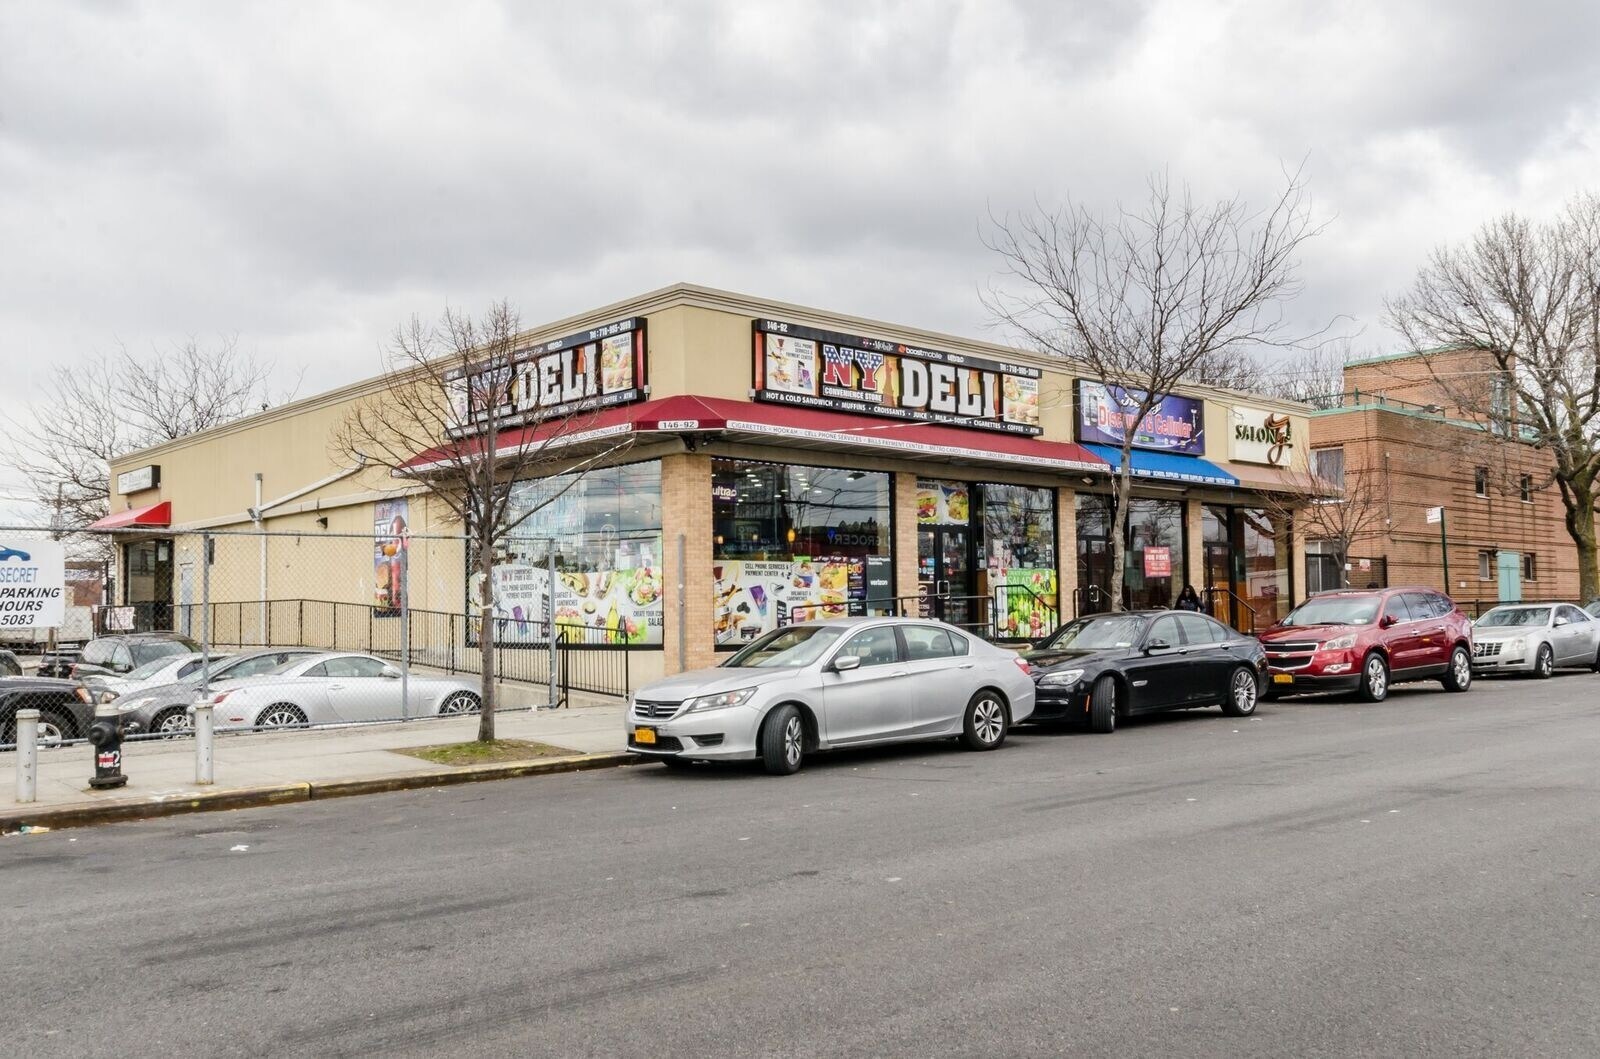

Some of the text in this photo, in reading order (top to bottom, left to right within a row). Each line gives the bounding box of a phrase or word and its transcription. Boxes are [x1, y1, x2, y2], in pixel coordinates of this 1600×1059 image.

[517, 343, 598, 410] DELI
[823, 344, 996, 418] NY DELI
[602, 395, 618, 404] COFFEE
[824, 386, 882, 402] CONVENIENCE STORE
[766, 392, 779, 400] HOT
[786, 394, 801, 403] COLD
[802, 396, 833, 407] SANDWICH
[842, 402, 866, 412] MUFFINS
[874, 406, 906, 417] CROISSANTS
[913, 412, 928, 420] JUICE
[974, 419, 1001, 429] CIGARETTES
[1007, 424, 1024, 432] COFFEE
[661, 420, 696, 430] 146-92
[1146, 412, 1154, 433] &
[1155, 414, 1192, 438] Cellular
[1236, 424, 1276, 444] SALON
[731, 422, 768, 432] CIGARETTES
[804, 430, 818, 438] CELL
[818, 431, 838, 440] PHONE
[838, 434, 862, 443] SERVICES
[882, 440, 904, 448] PAYMENT
[905, 442, 924, 450] CENTER
[0, 567, 38, 583] SECRET
[0, 588, 60, 598] PARKING
[0, 614, 35, 626] 5083
